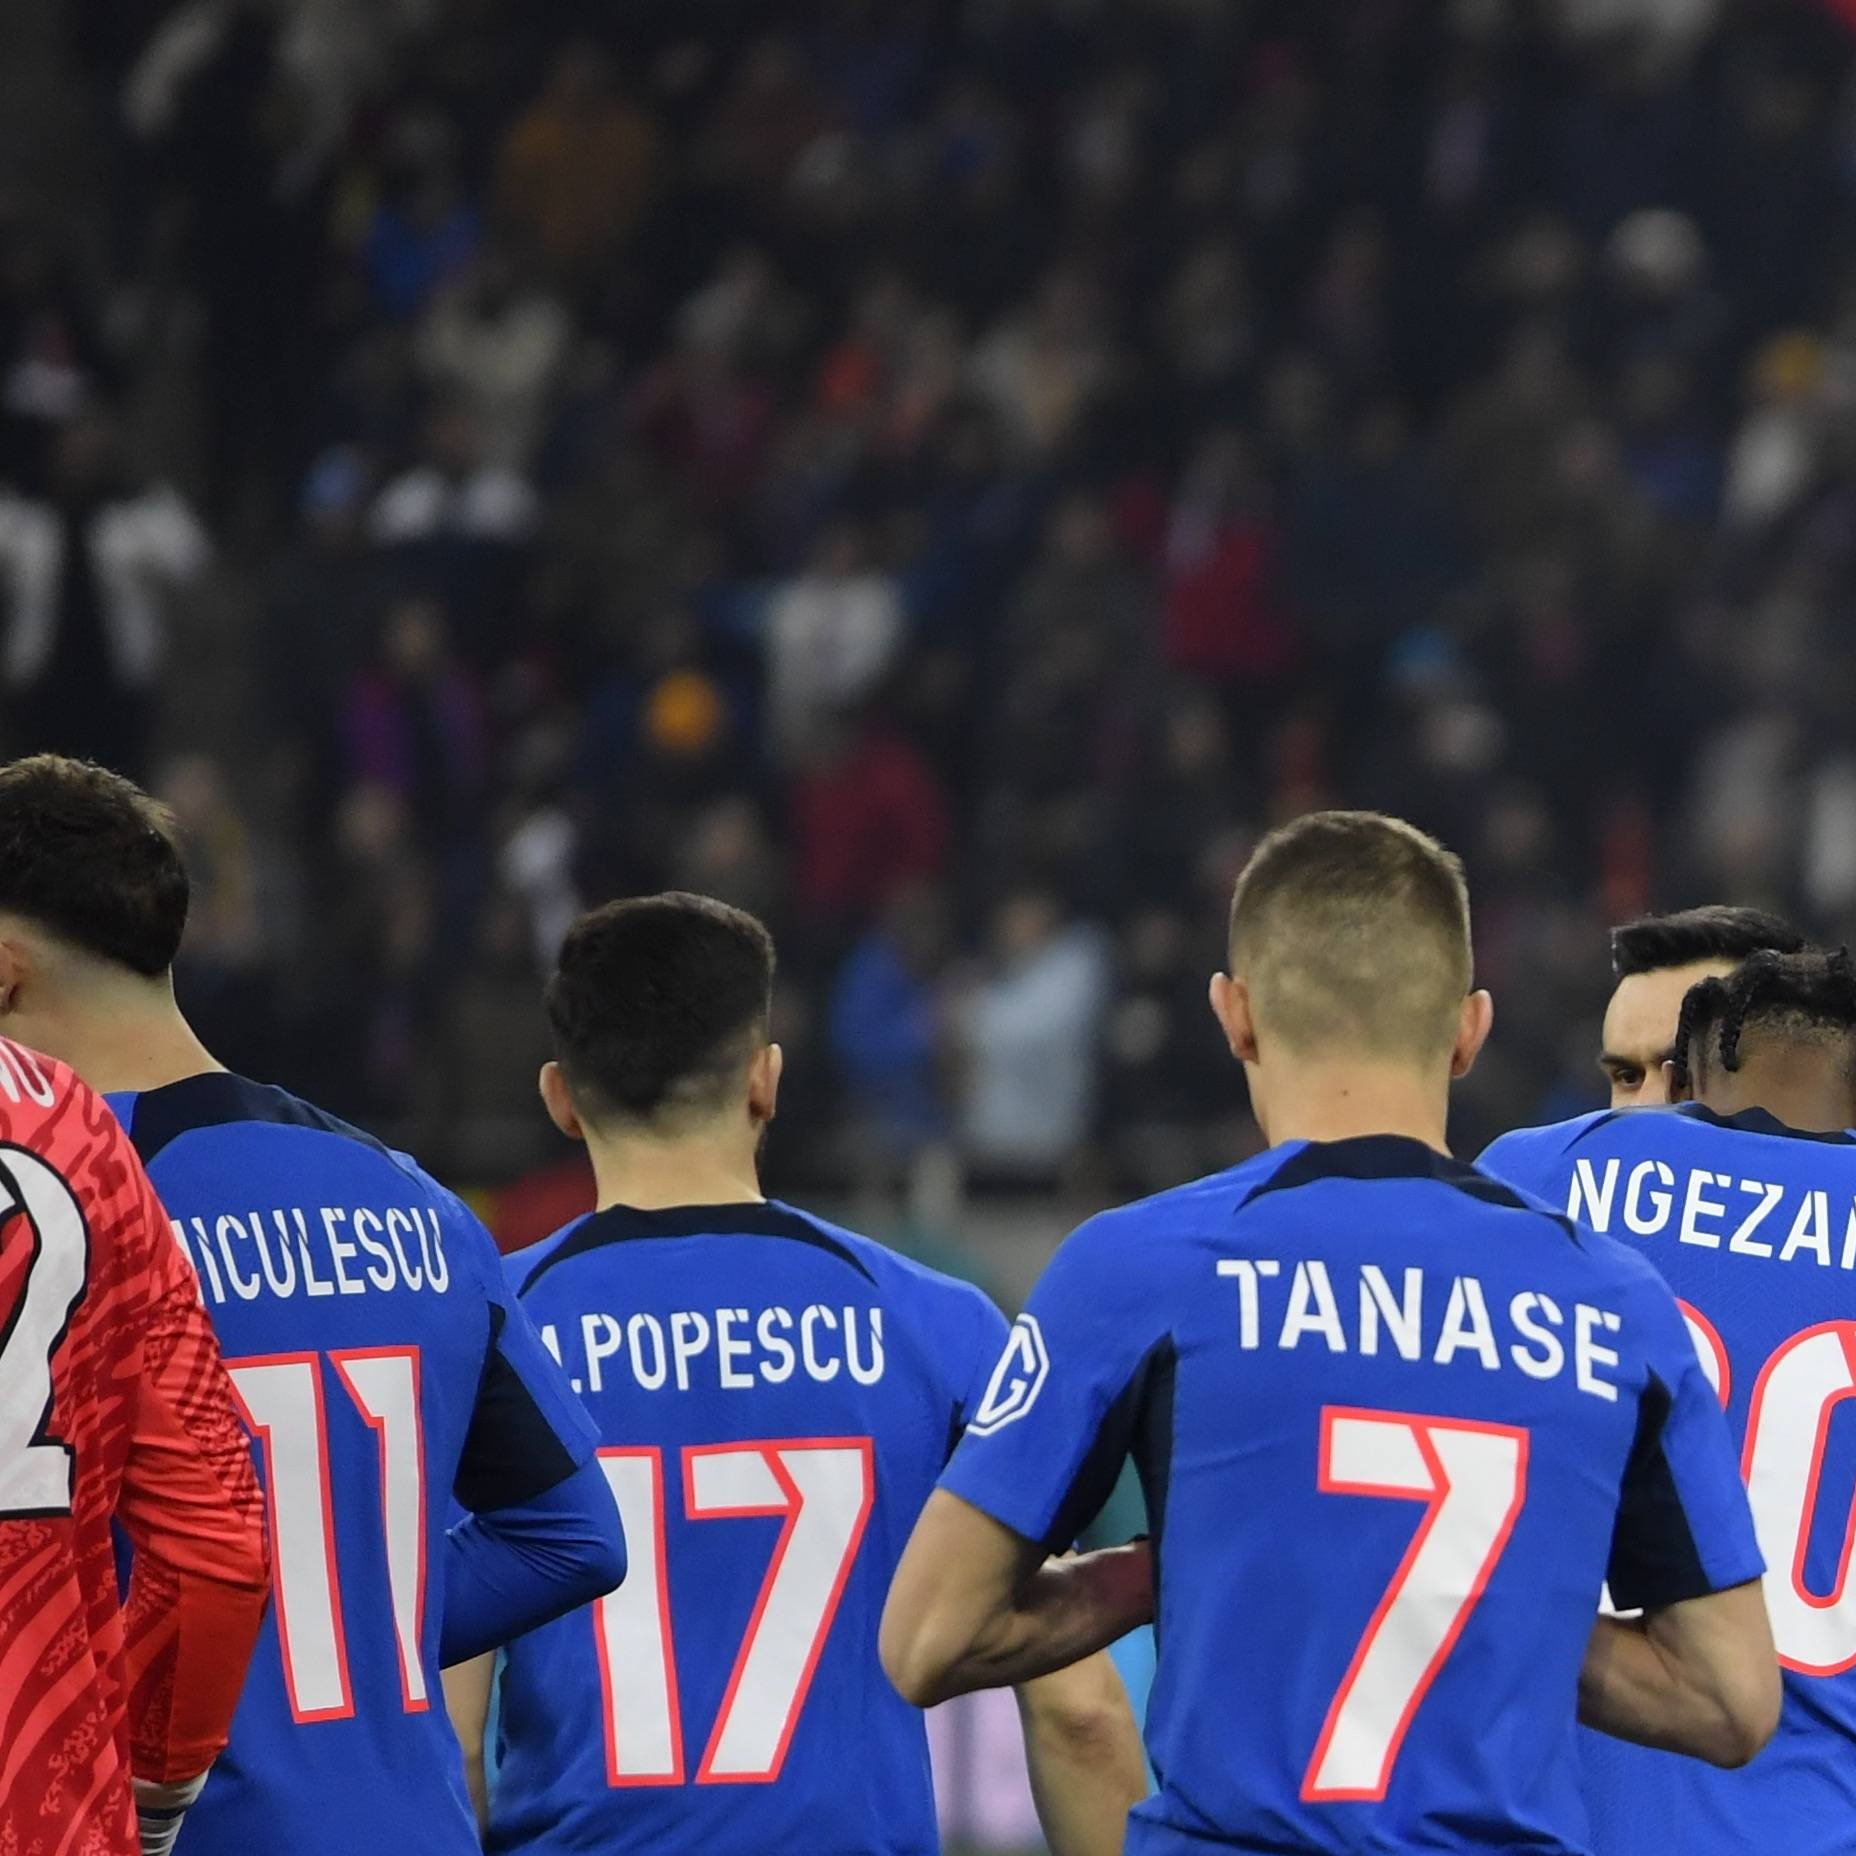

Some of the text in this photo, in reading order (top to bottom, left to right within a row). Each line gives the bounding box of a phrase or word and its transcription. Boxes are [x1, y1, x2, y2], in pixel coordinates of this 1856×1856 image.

[541, 1306, 884, 1393] .POPESCU
[1216, 1260, 1621, 1402] TANASE
[226, 1346, 429, 1724] 11
[594, 1437, 873, 1787] 17
[1301, 1405, 1529, 1802] 7
